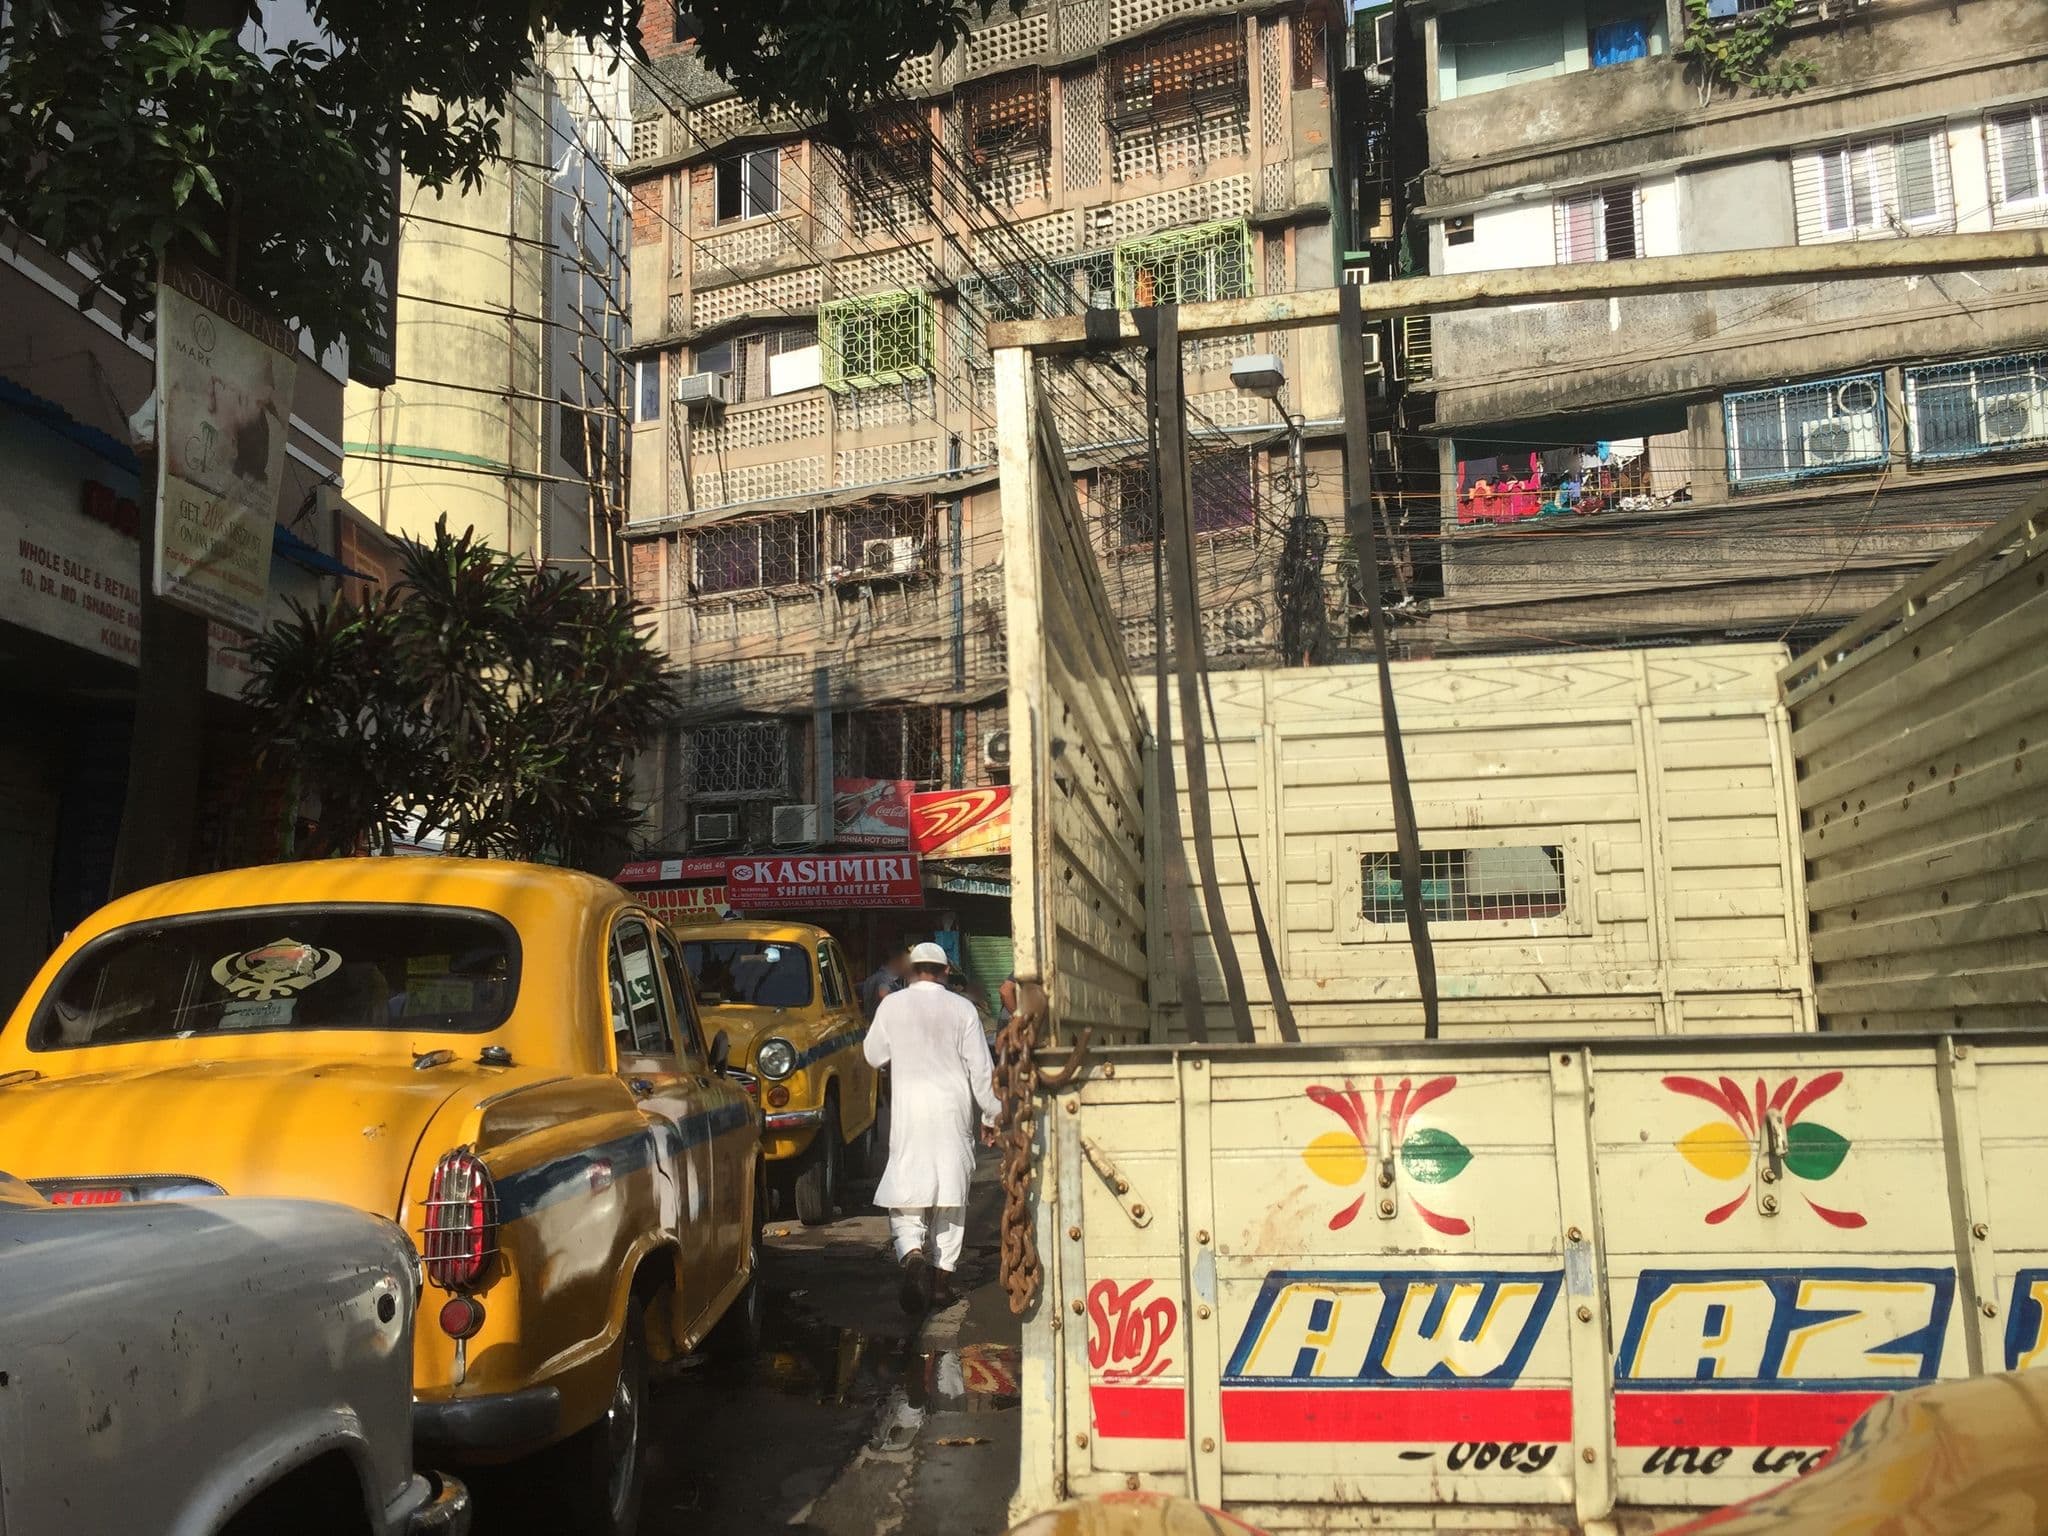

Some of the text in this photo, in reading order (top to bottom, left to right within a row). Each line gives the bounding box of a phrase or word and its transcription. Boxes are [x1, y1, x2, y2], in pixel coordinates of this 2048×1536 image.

[172, 264, 297, 358] NOW OPENED
[176, 340, 212, 369] MARK
[19, 539, 60, 573] WHOLE
[63, 558, 91, 585] SALE
[94, 572, 101, 590] &
[104, 577, 141, 608] RETAIL
[100, 627, 140, 657] KOLKA
[864, 836, 881, 845] HOT
[625, 867, 645, 876] airtel
[693, 862, 713, 872] airtel
[714, 860, 726, 870] 4G
[753, 858, 913, 884] KASHMIRI
[634, 888, 698, 909] CONOMY
[776, 885, 830, 897] SHAWL
[833, 883, 890, 896] OUTLET
[852, 898, 892, 906] KOLKATA
